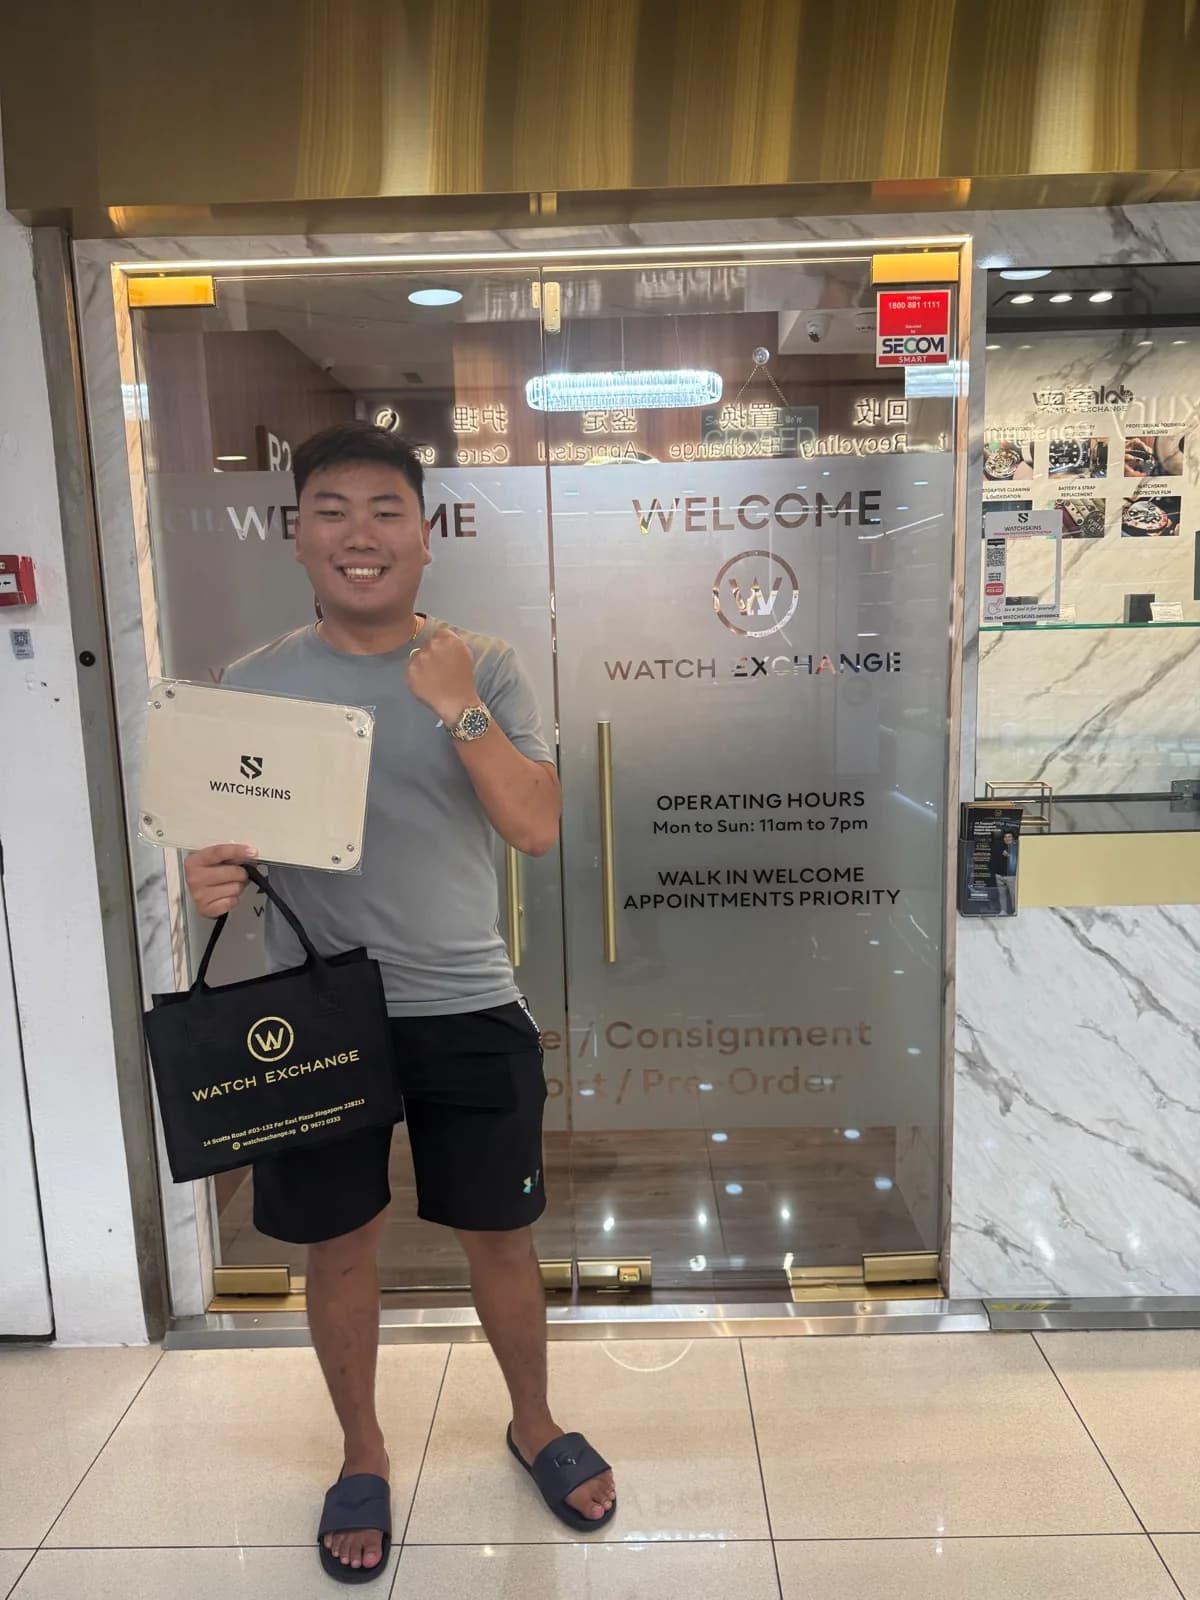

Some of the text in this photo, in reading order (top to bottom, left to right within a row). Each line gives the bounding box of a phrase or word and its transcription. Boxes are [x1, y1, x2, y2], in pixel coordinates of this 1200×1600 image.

[882, 337, 944, 354] SECOM
[898, 356, 928, 364] SMART
[632, 490, 882, 535] WELCOME
[603, 651, 900, 681] WATCH EXCHANGE
[209, 780, 291, 800] WATCHSKINS
[656, 791, 866, 811] OPERATING HOURS
[652, 816, 868, 835] Mon to Sun: 11am to 7pm
[658, 866, 865, 886] WALK IN WELCOME
[623, 889, 900, 910] APPOINTMENTS PRIORITY
[605, 1019, 872, 1056] Consignment
[192, 1049, 361, 1102] WATCH EXCHANGE
[212, 1134, 230, 1145] Scotts
[232, 1130, 247, 1140] Road
[274, 1120, 284, 1129] Far
[284, 1118, 298, 1127] East
[298, 1113, 314, 1122] Plaza
[314, 1105, 343, 1118] Singapore
